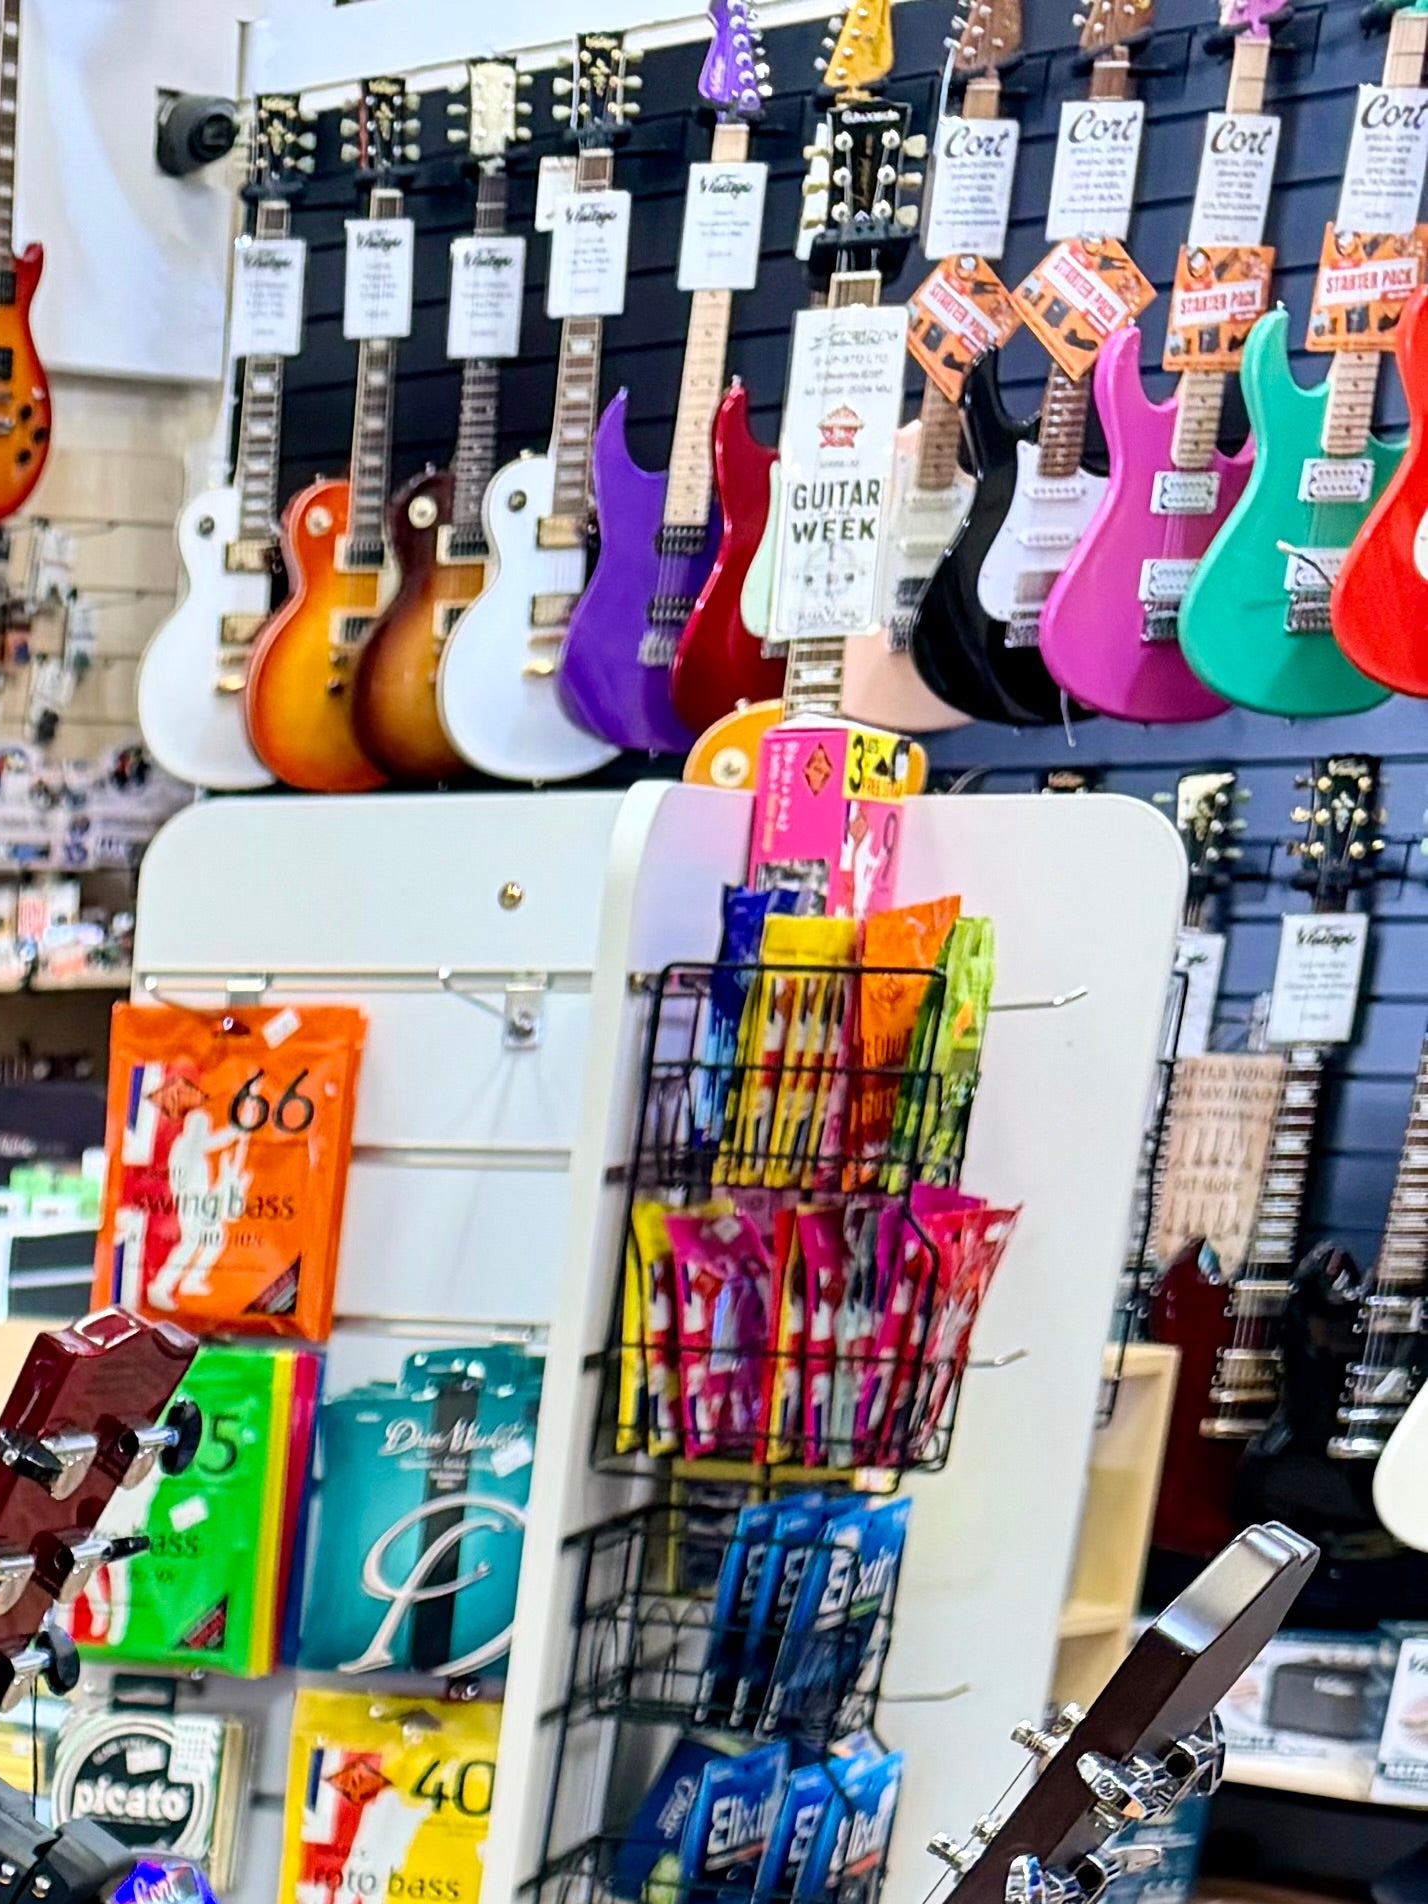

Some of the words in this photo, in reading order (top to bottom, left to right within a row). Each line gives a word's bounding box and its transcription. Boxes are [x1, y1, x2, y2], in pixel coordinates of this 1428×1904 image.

[1068, 109, 1137, 143] Cort
[1360, 94, 1428, 129] Cort
[944, 125, 1010, 159] Cort
[1210, 120, 1273, 155] Cort
[793, 479, 881, 511] GUITAR
[791, 517, 876, 544] WEEK
[228, 1068, 315, 1133] 66
[227, 1185, 294, 1220] bass
[197, 1412, 238, 1475] 5
[72, 1773, 192, 1822] picato
[410, 1759, 495, 1818] 40
[387, 1864, 461, 1902] bass
